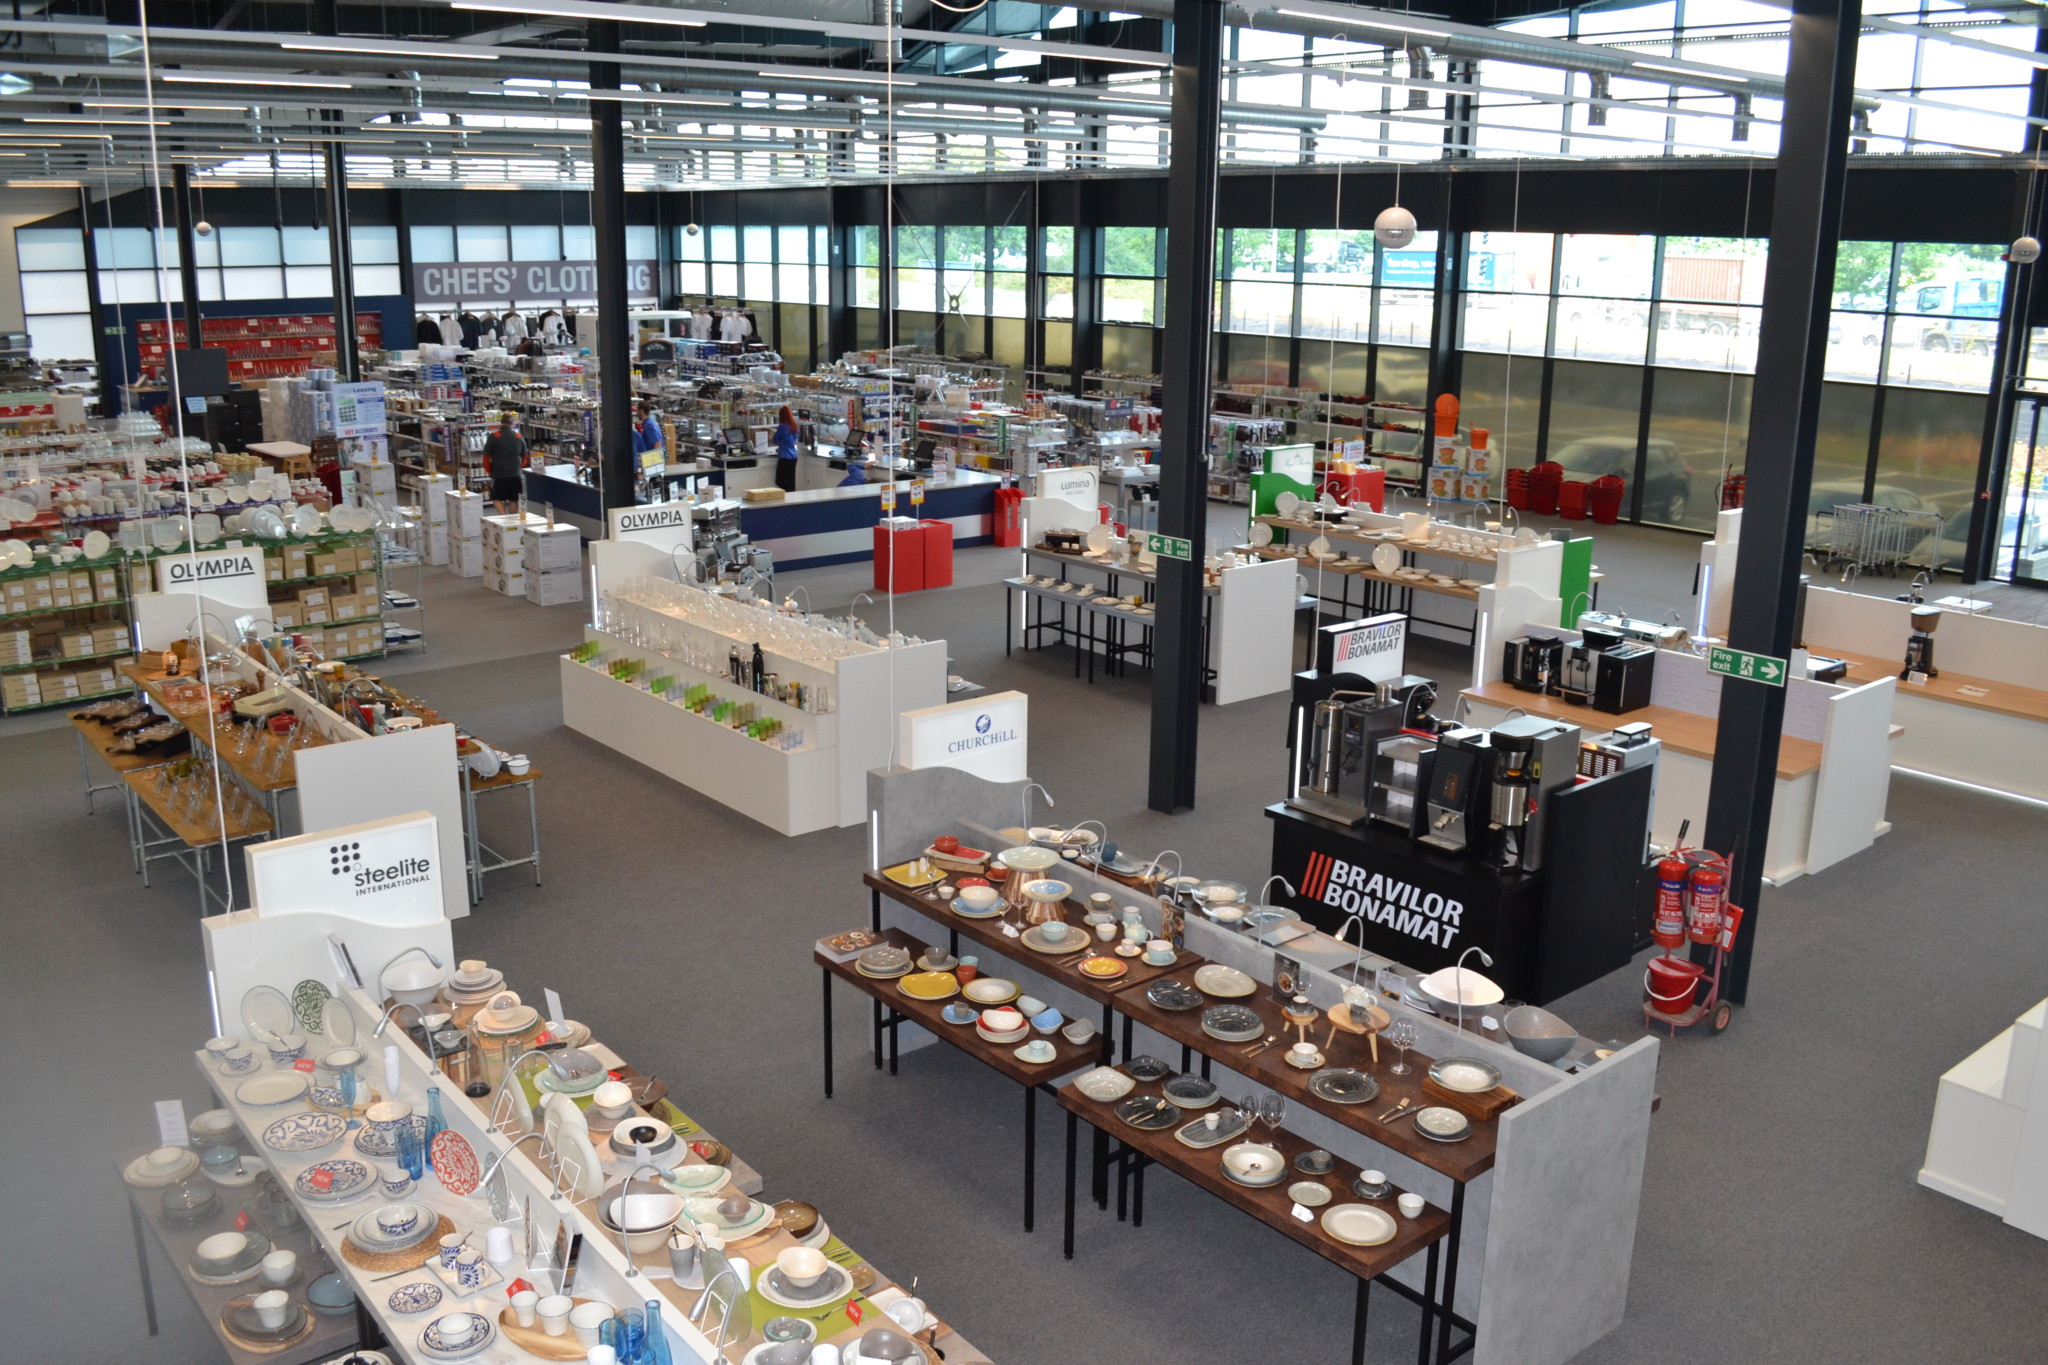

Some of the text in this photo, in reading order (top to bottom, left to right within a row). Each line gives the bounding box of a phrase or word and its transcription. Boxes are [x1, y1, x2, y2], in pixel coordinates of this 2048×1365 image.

[527, 265, 650, 293] CLOTG
[621, 510, 683, 528] OLYMPIA
[1176, 541, 1189, 550] Fire
[170, 557, 254, 579] OLYMPIA
[1350, 624, 1402, 646] BRAVILOR
[1347, 637, 1400, 660] BONAMAT
[1712, 649, 1733, 662] Fire
[1712, 661, 1731, 671] exit
[354, 857, 430, 887] steelite
[355, 874, 431, 896] INTERNATIONAL
[1330, 859, 1464, 927] BRAVILOR
[1323, 882, 1460, 949] BONAMAT
[315, 1174, 329, 1183] NEW
[848, 1305, 860, 1318] NEW
